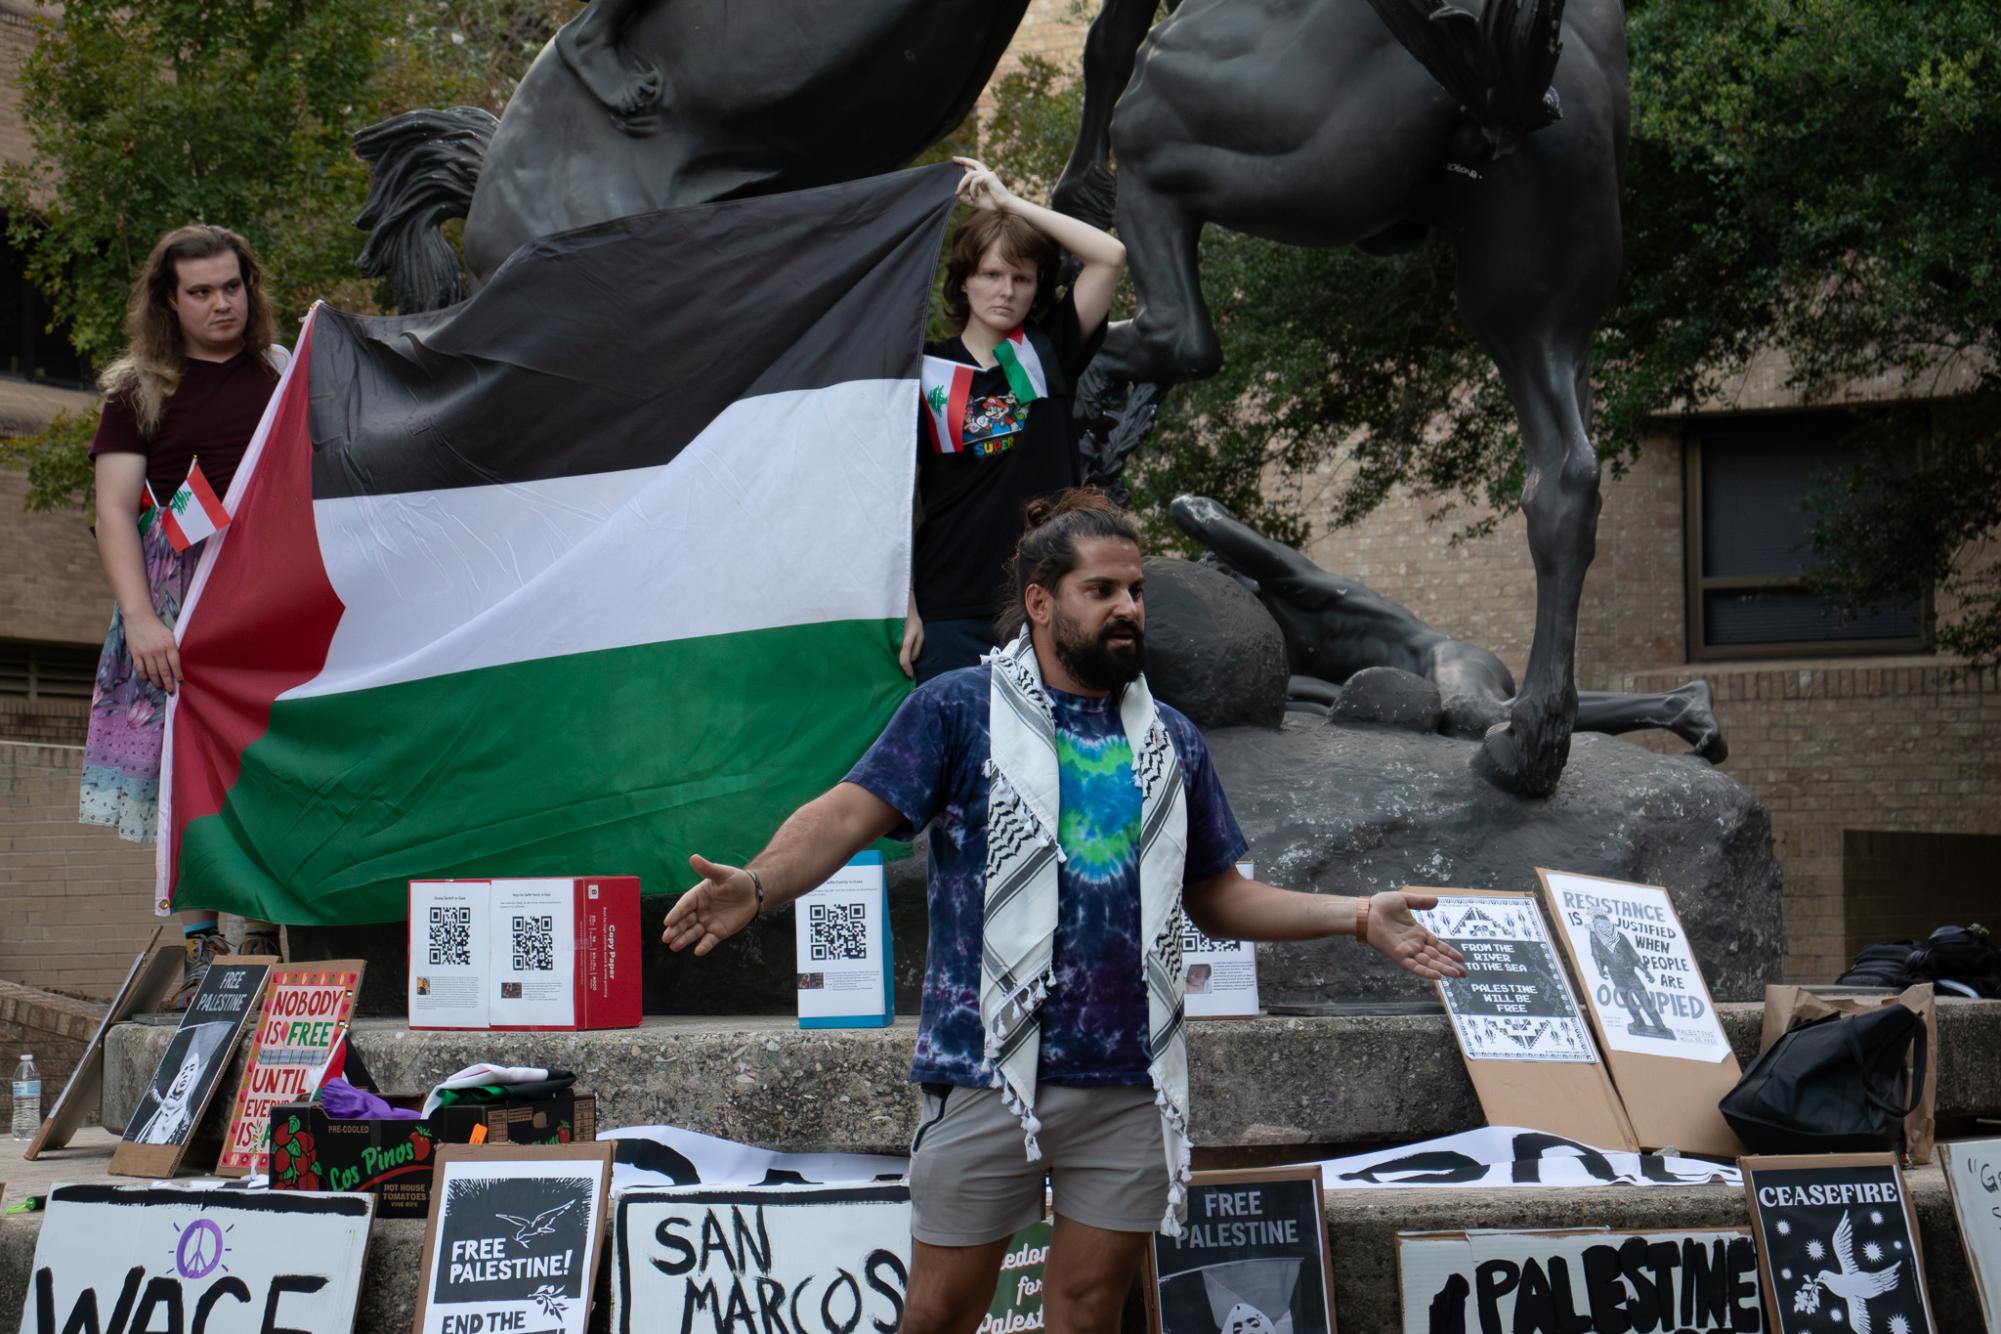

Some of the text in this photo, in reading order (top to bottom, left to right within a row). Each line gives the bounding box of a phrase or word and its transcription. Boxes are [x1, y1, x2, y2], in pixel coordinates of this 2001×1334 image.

[975, 436, 1015, 456] SUPER
[1563, 891, 1666, 922] RESISTANCE
[1568, 911, 1583, 927] IS
[1615, 918, 1677, 939] JUSTIFIED
[608, 924, 616, 950] Copy
[1635, 935, 1670, 954] WHEN
[1461, 943, 1515, 953] FROM THE
[1473, 953, 1511, 962] RIVER
[1465, 962, 1527, 973] TO THE SEA
[1642, 955, 1690, 972] PEOPLE
[219, 970, 246, 989] FREE
[1470, 983, 1538, 994] PALESTINE
[1660, 973, 1685, 989] ARE
[196, 993, 247, 1011] PALESTINE
[272, 989, 345, 1016] NOBODY
[1483, 994, 1531, 1003] WILL BE
[1496, 1004, 1527, 1013] FREE
[264, 1021, 334, 1047] IS FREE
[251, 1068, 306, 1094] UNTIL
[236, 1121, 253, 1146] IS
[328, 1125, 369, 1134] PRE-COOLED
[361, 1142, 414, 1175] Pinos
[383, 1192, 427, 1200] TOMATOES
[384, 1183, 425, 1191] HOT HOUSE
[1758, 1182, 1898, 1207] CEASEFIRE
[1204, 1191, 1263, 1217] FREE
[650, 1204, 771, 1276] SAN
[1176, 1219, 1299, 1249] PALESTINE
[452, 1238, 506, 1262] FREE
[450, 1249, 573, 1284] PALESTINE!
[681, 1248, 908, 1334] MARCOS
[1475, 1236, 1761, 1334] PALESTINE
[441, 1311, 526, 1334] END THE
